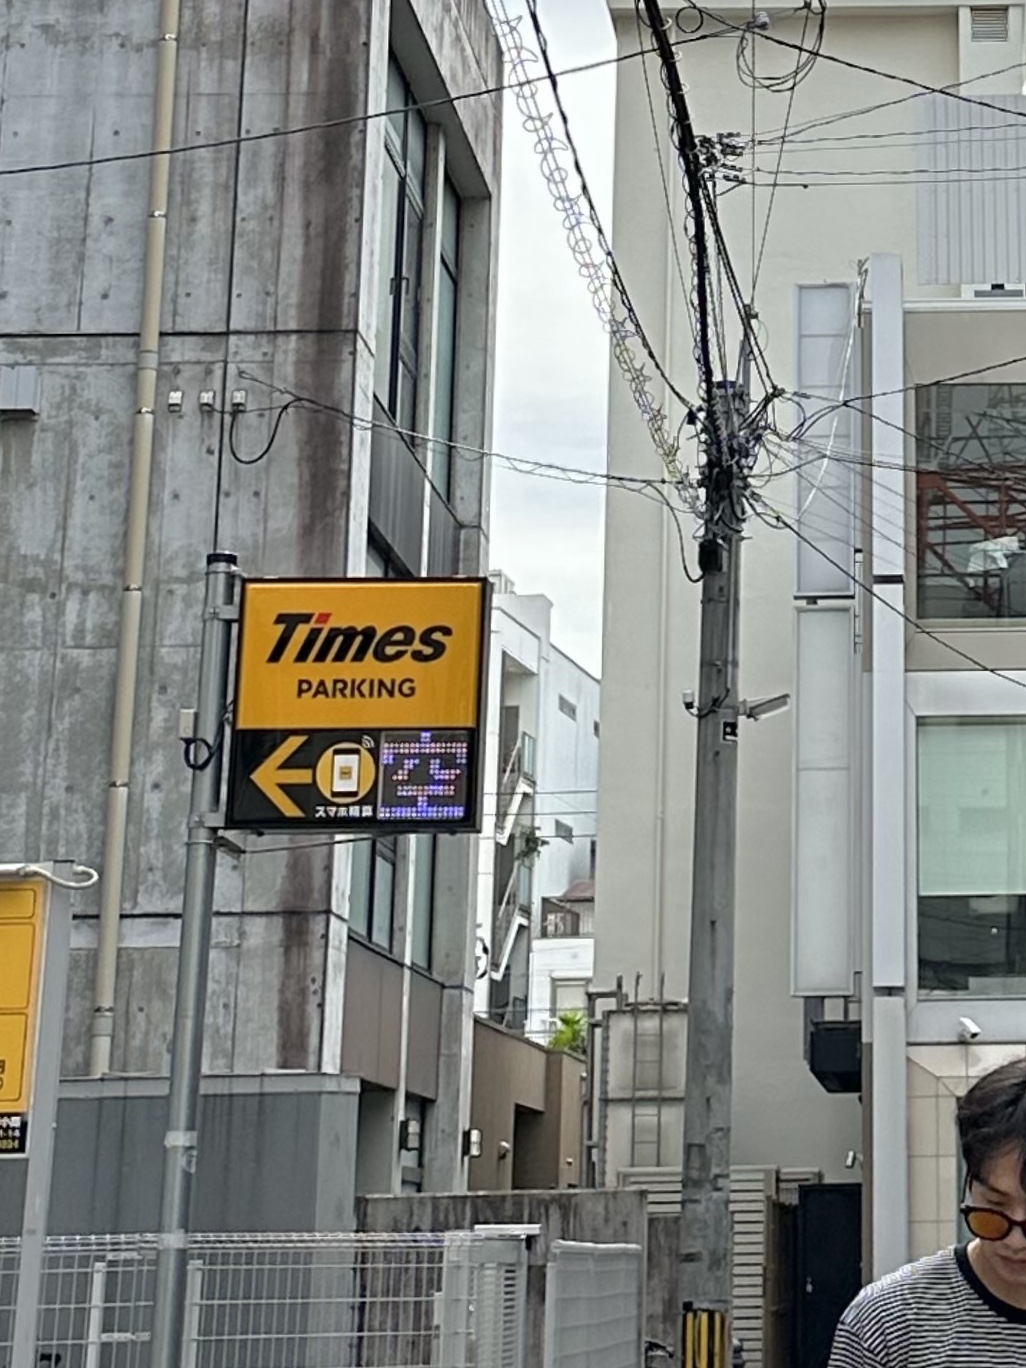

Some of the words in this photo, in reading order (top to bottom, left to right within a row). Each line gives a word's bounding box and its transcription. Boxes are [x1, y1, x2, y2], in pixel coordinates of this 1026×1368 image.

[266, 613, 453, 663] Times
[297, 678, 416, 698] PARKING
[381, 732, 468, 819] 空
